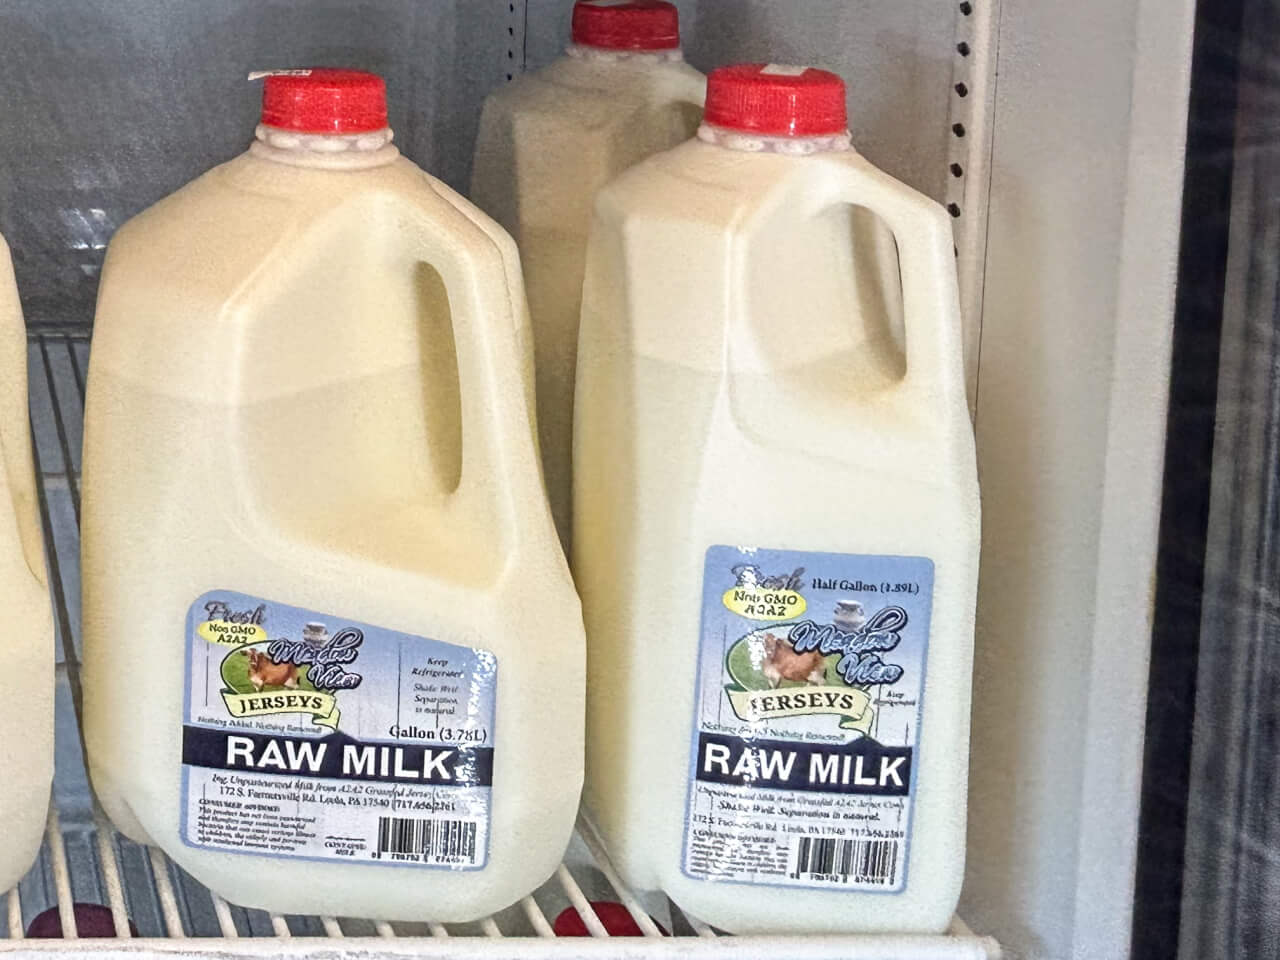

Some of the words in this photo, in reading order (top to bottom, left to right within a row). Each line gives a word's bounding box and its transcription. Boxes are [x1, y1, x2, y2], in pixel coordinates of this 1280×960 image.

[812, 578, 836, 590] Half
[839, 579, 878, 592] Gallon
[764, 593, 798, 606] GMO
[205, 600, 267, 624] Fresh
[209, 623, 229, 633] Non
[230, 626, 256, 635] GMO
[216, 635, 248, 644] A2A2
[239, 695, 323, 714] JERSEYS
[389, 725, 435, 739] Gallon
[439, 726, 487, 743] (3.78L)
[226, 735, 326, 772] RAW
[342, 744, 455, 780] MILK
[703, 742, 798, 781] RAW
[809, 754, 908, 788] MILK
